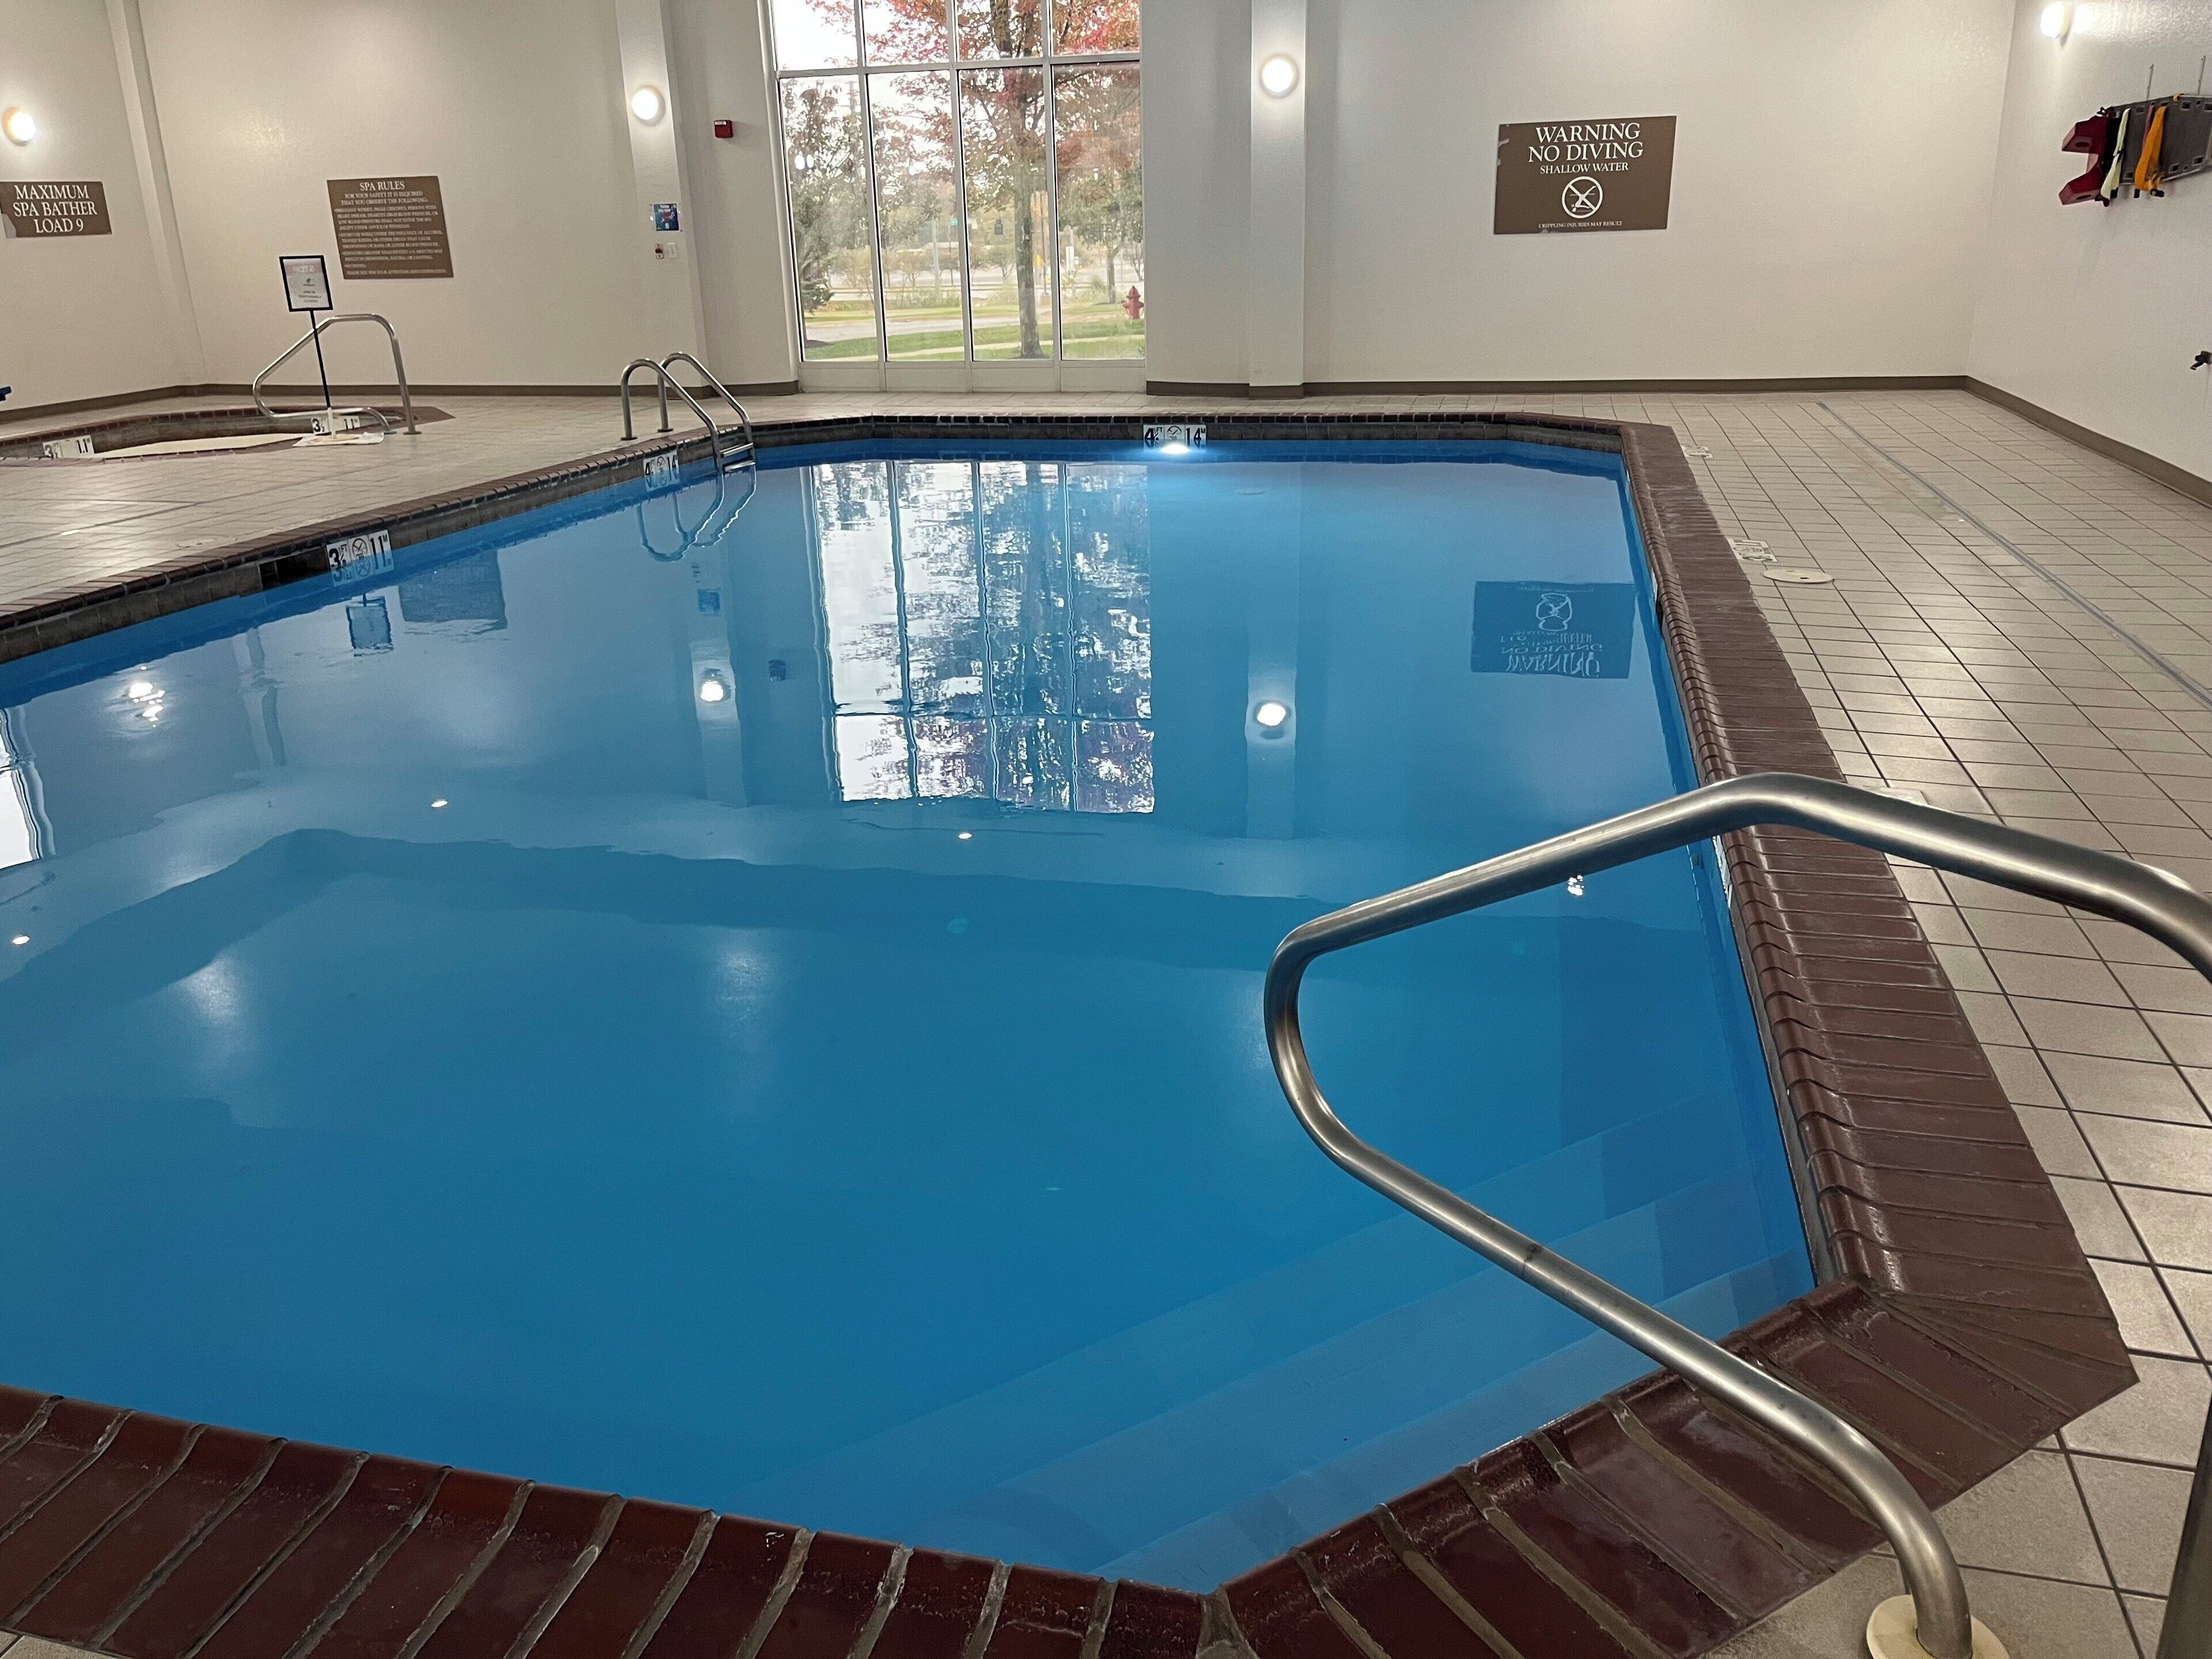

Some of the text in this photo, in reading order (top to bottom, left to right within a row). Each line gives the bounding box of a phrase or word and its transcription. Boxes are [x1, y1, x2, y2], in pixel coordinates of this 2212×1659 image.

[1535, 122, 1641, 143] WARNING
[1528, 141, 1644, 163] NO DIVING
[1540, 162, 1629, 175] SHALLOW WATER
[14, 184, 89, 200] MAXIMUM
[359, 180, 406, 191] SPA RULES
[13, 201, 98, 217] SPA BATHER
[33, 218, 84, 233] LOAD 9
